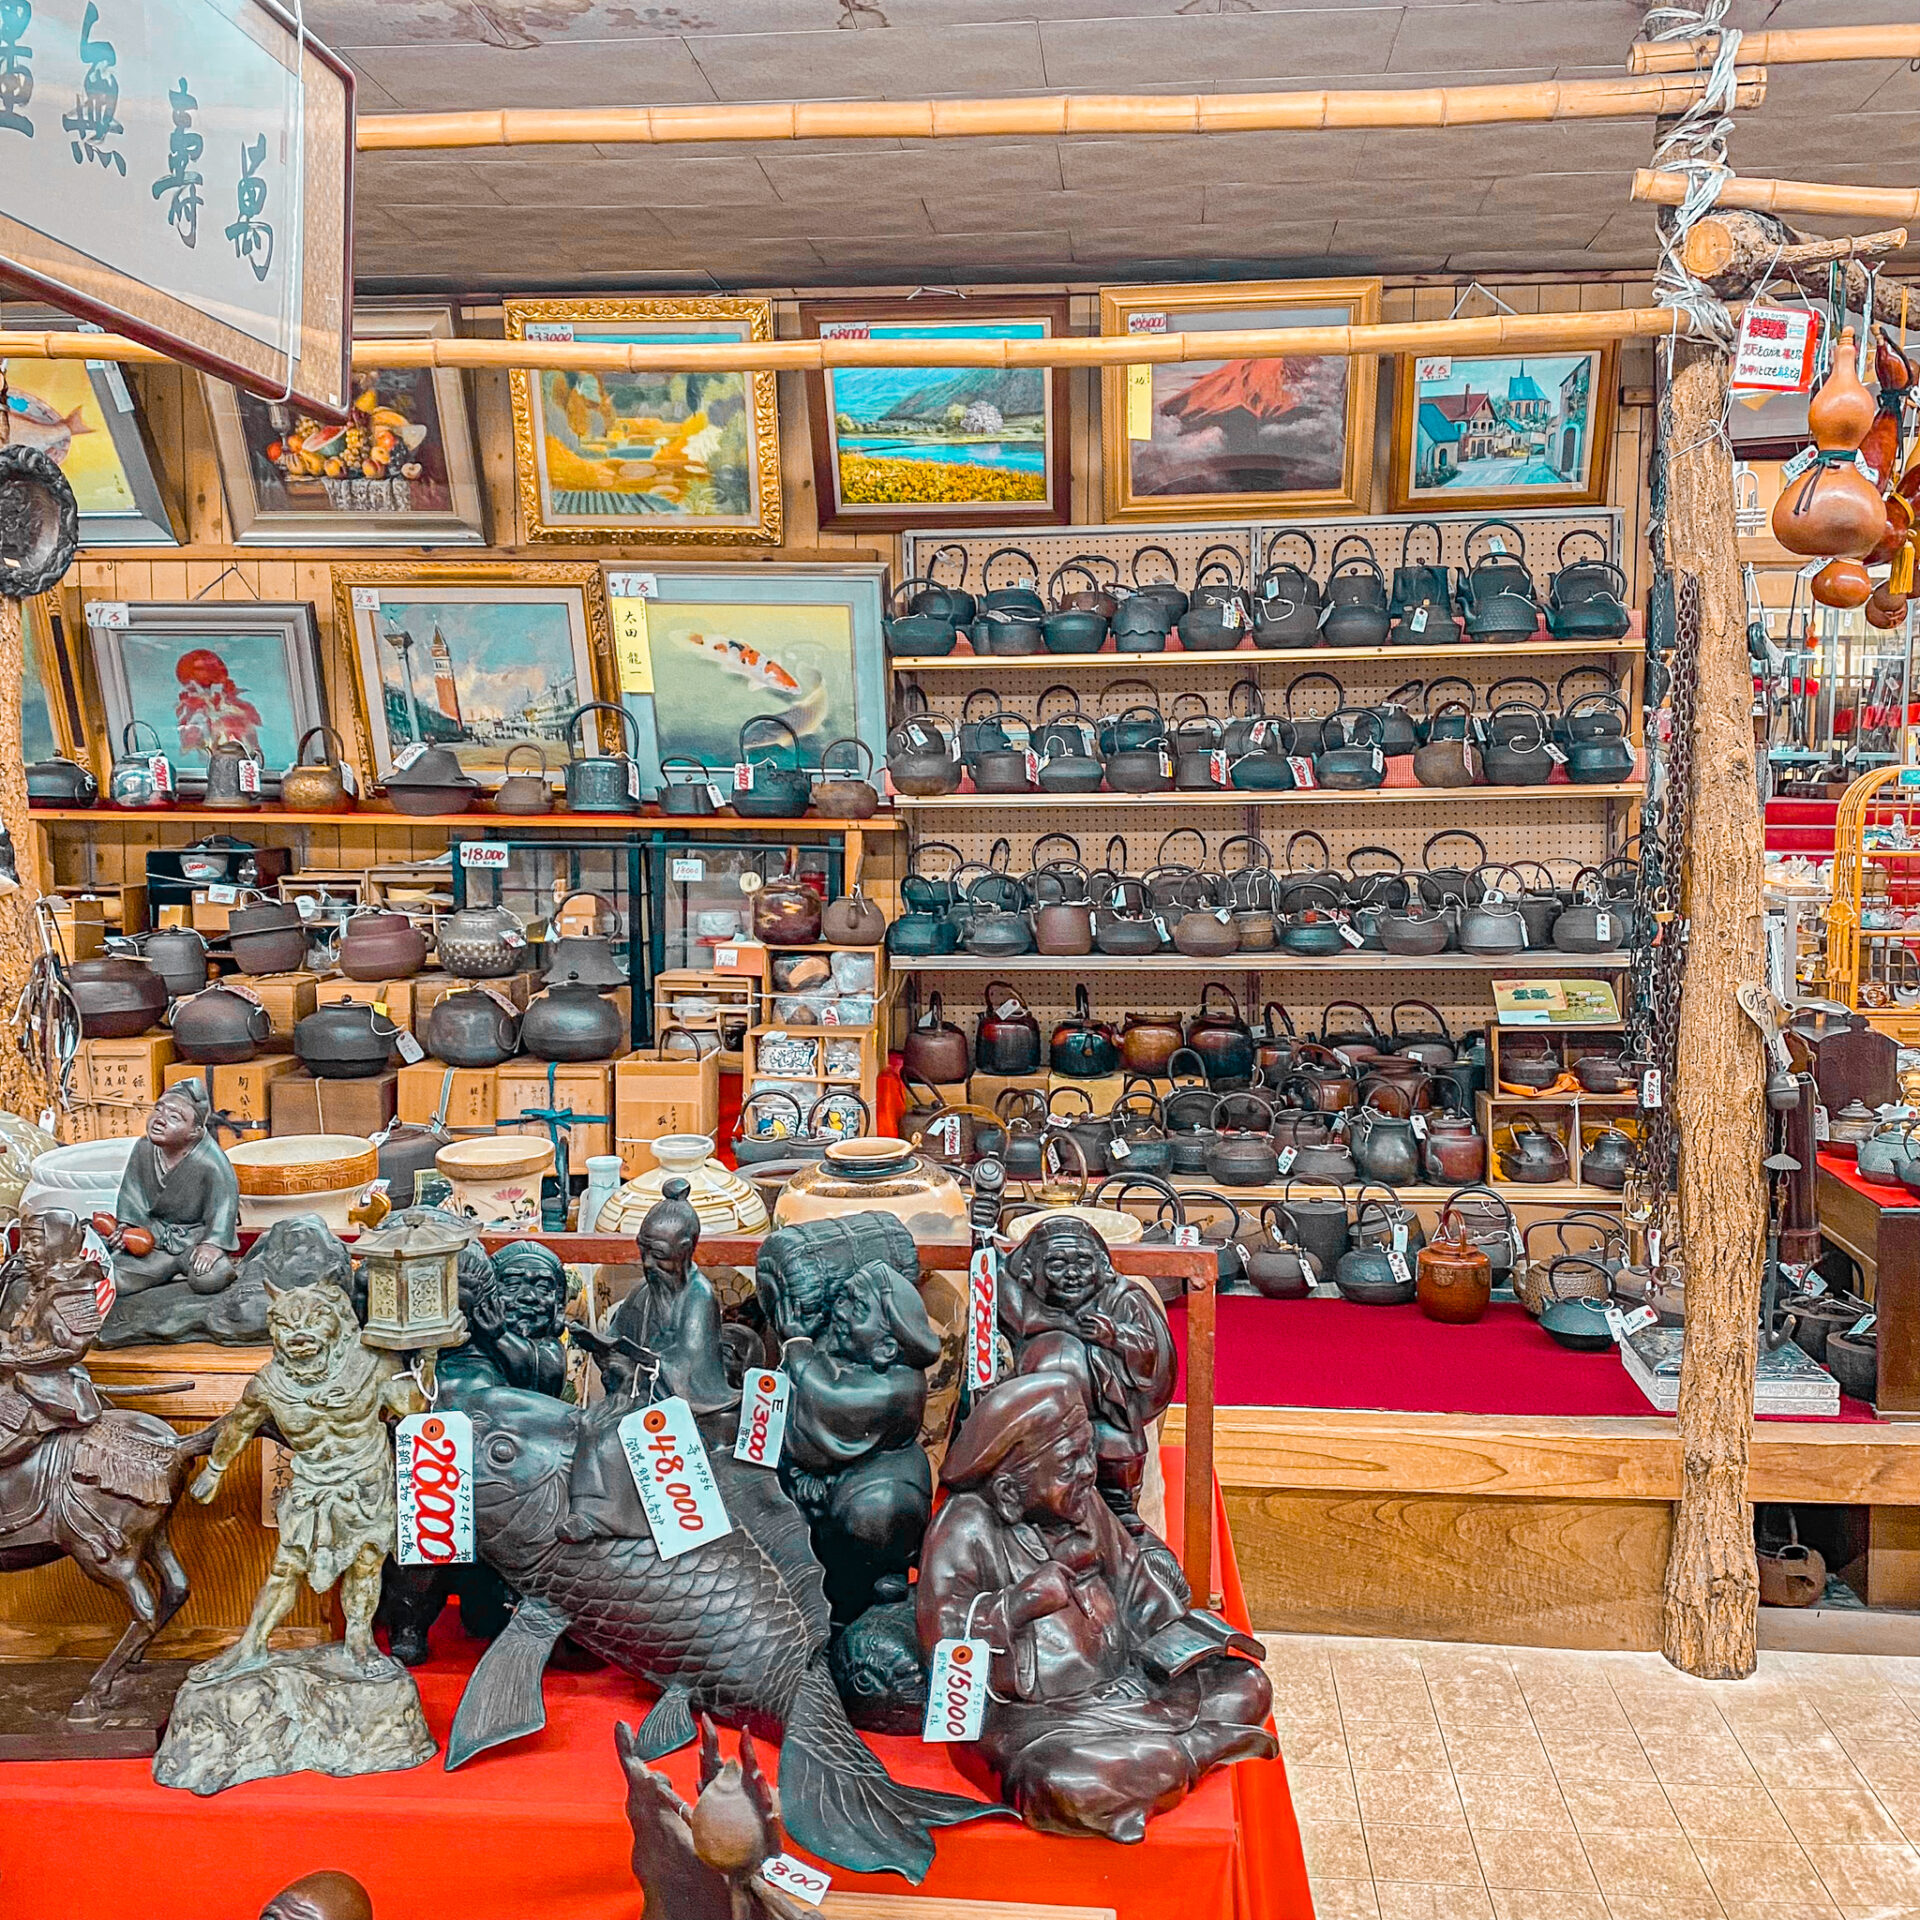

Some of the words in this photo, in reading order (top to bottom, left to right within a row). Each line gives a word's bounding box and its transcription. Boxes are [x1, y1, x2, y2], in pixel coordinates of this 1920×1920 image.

[624, 610, 638, 639] 太田
[974, 1273, 994, 1383] 9800
[771, 1861, 824, 1891] 800
